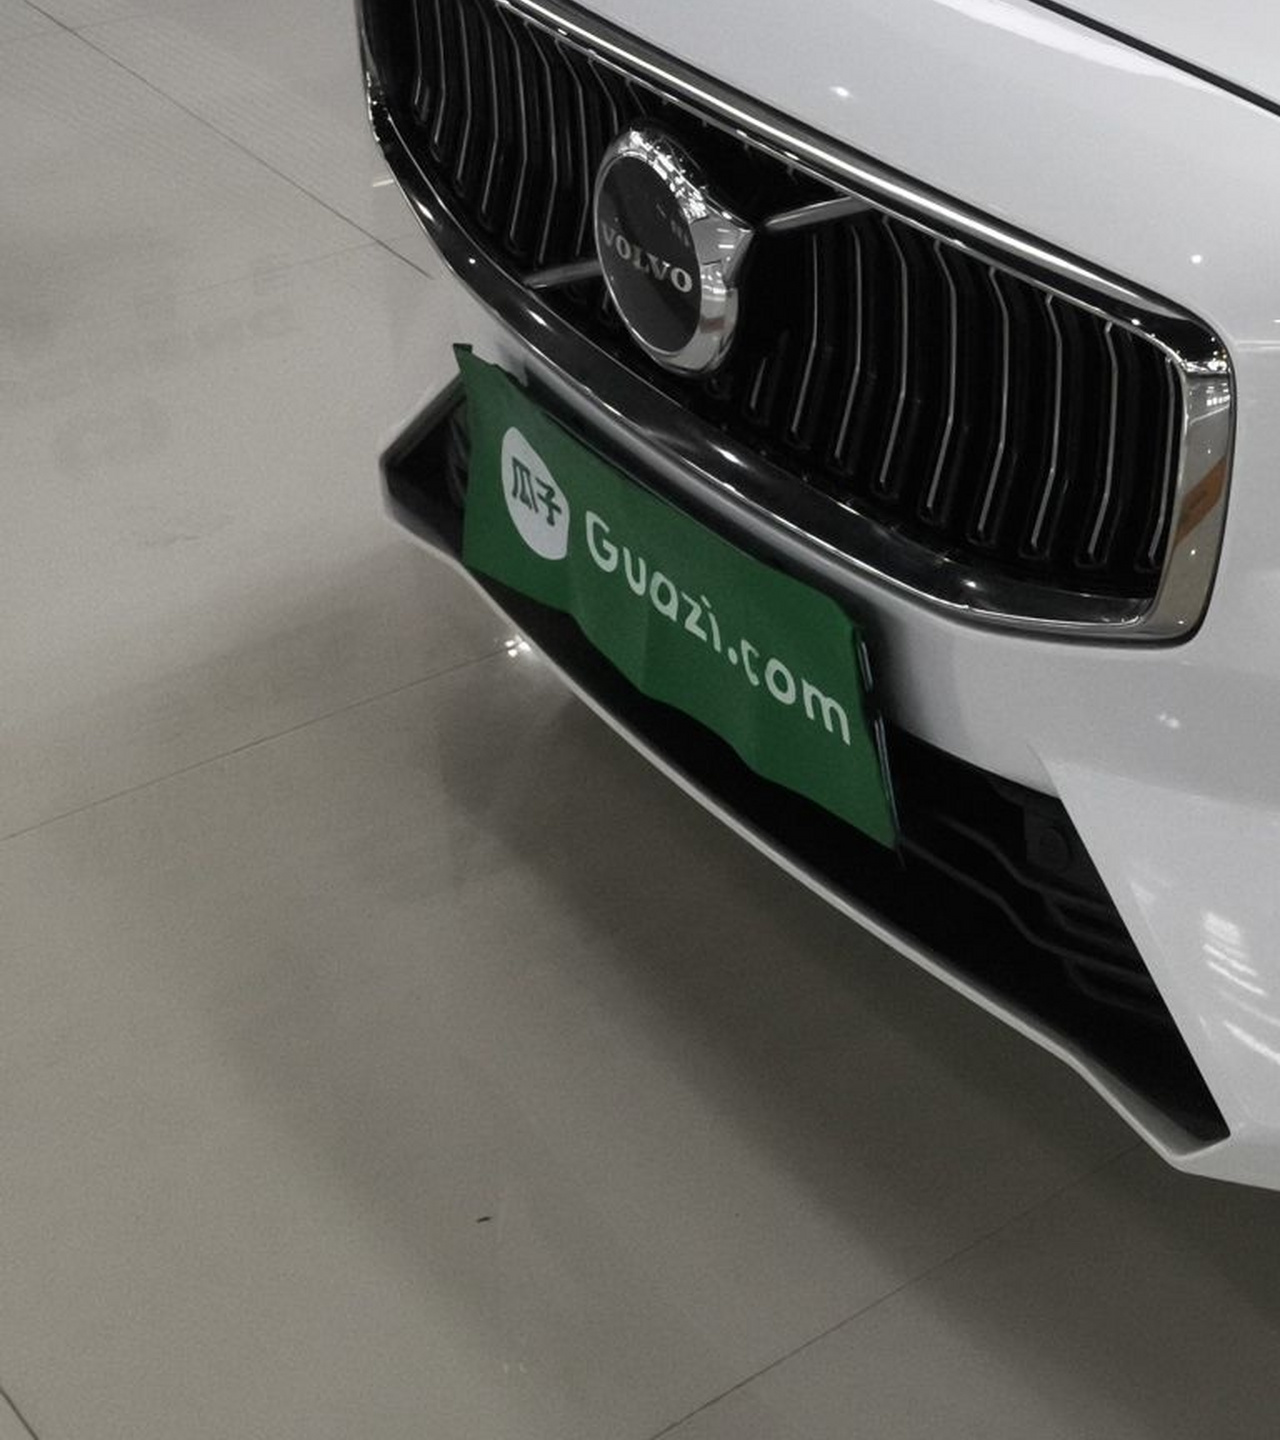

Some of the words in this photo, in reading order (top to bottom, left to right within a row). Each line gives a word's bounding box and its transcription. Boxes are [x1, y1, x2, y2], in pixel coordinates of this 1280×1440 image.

[600, 220, 693, 293] VOLVO
[511, 455, 563, 528] 瓜子
[585, 509, 851, 747] Guazi.com
